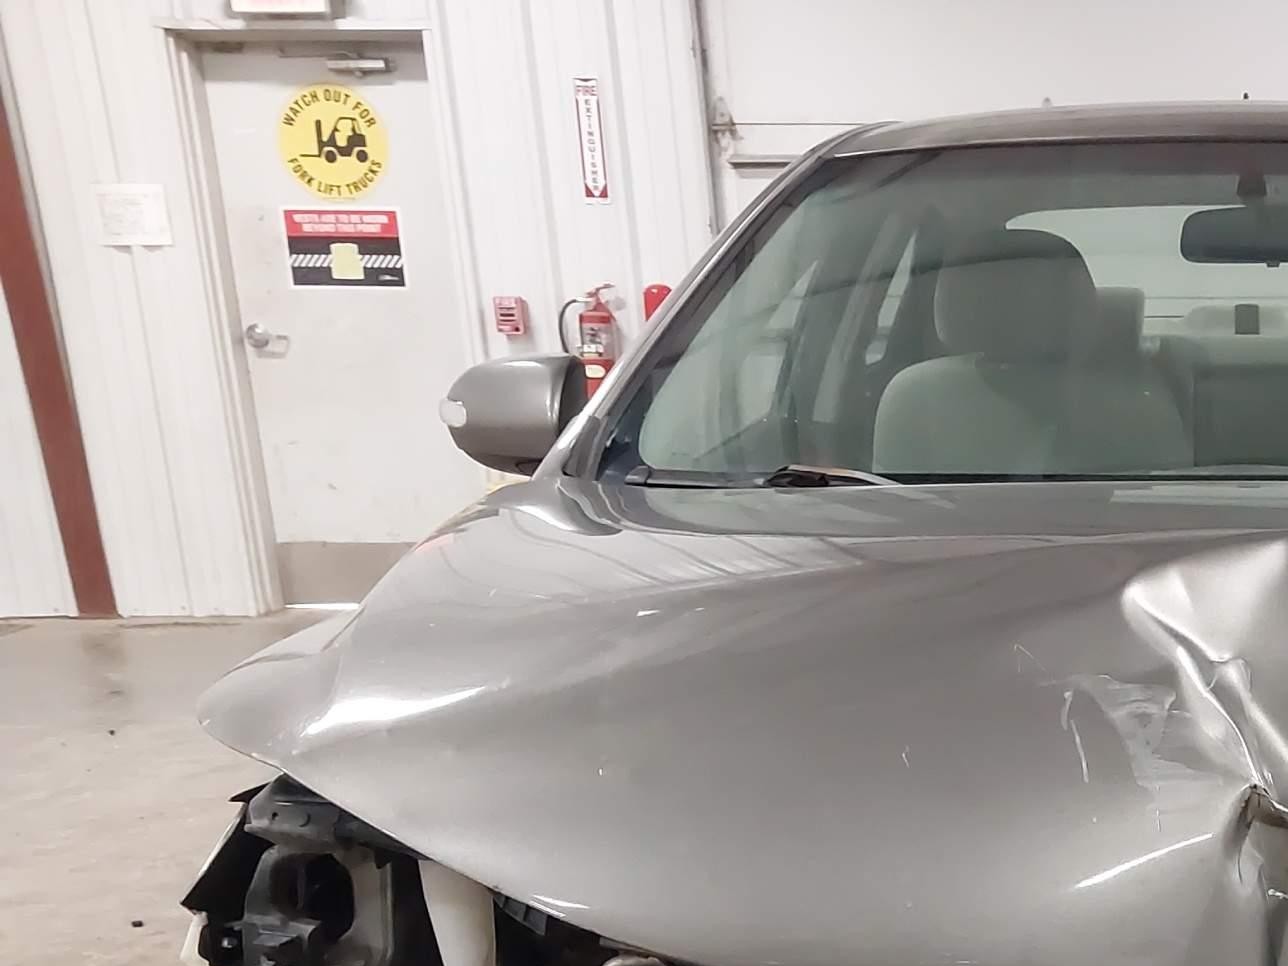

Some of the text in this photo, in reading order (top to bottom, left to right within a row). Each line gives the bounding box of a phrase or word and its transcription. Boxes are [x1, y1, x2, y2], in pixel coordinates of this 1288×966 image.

[282, 88, 377, 128] WATCH OUT FOR
[287, 157, 382, 197] FORK LIFT TRUCKS
